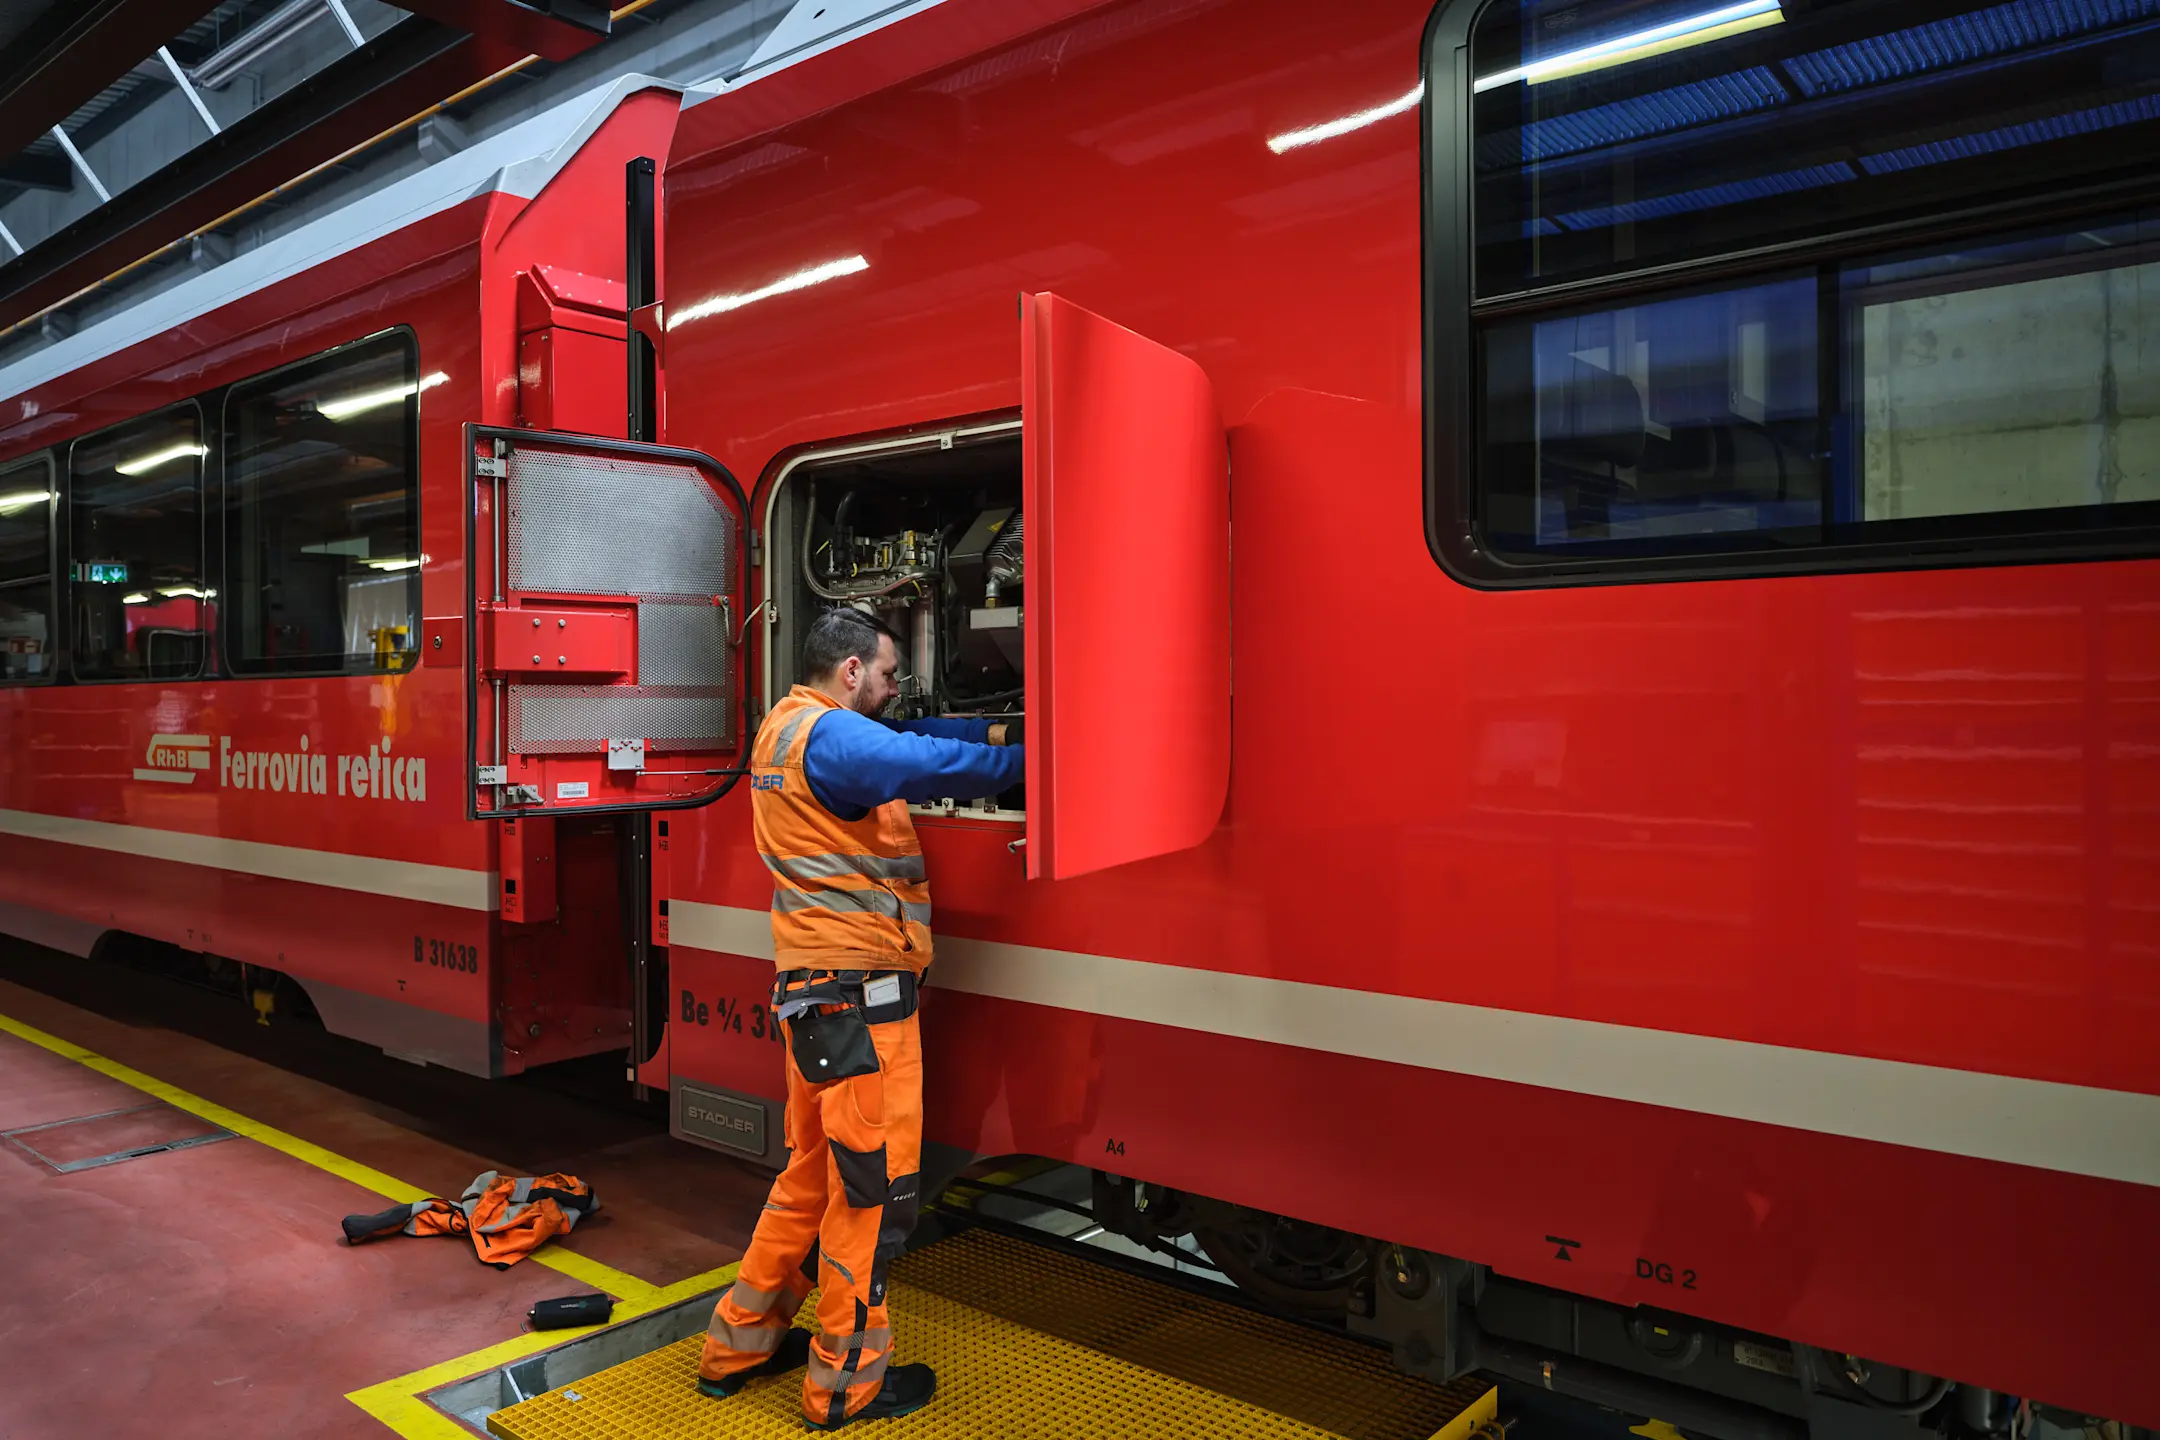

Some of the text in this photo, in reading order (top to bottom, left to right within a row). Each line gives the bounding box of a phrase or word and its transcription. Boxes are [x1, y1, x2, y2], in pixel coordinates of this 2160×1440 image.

[156, 749, 188, 768] RhB
[220, 734, 426, 801] Ferrovia retica
[414, 935, 478, 975] B 31638
[681, 989, 709, 1027] Be
[687, 1106, 755, 1135] STADLER
[1105, 1137, 1125, 1157] A4
[1636, 1257, 1698, 1291] DG 2
